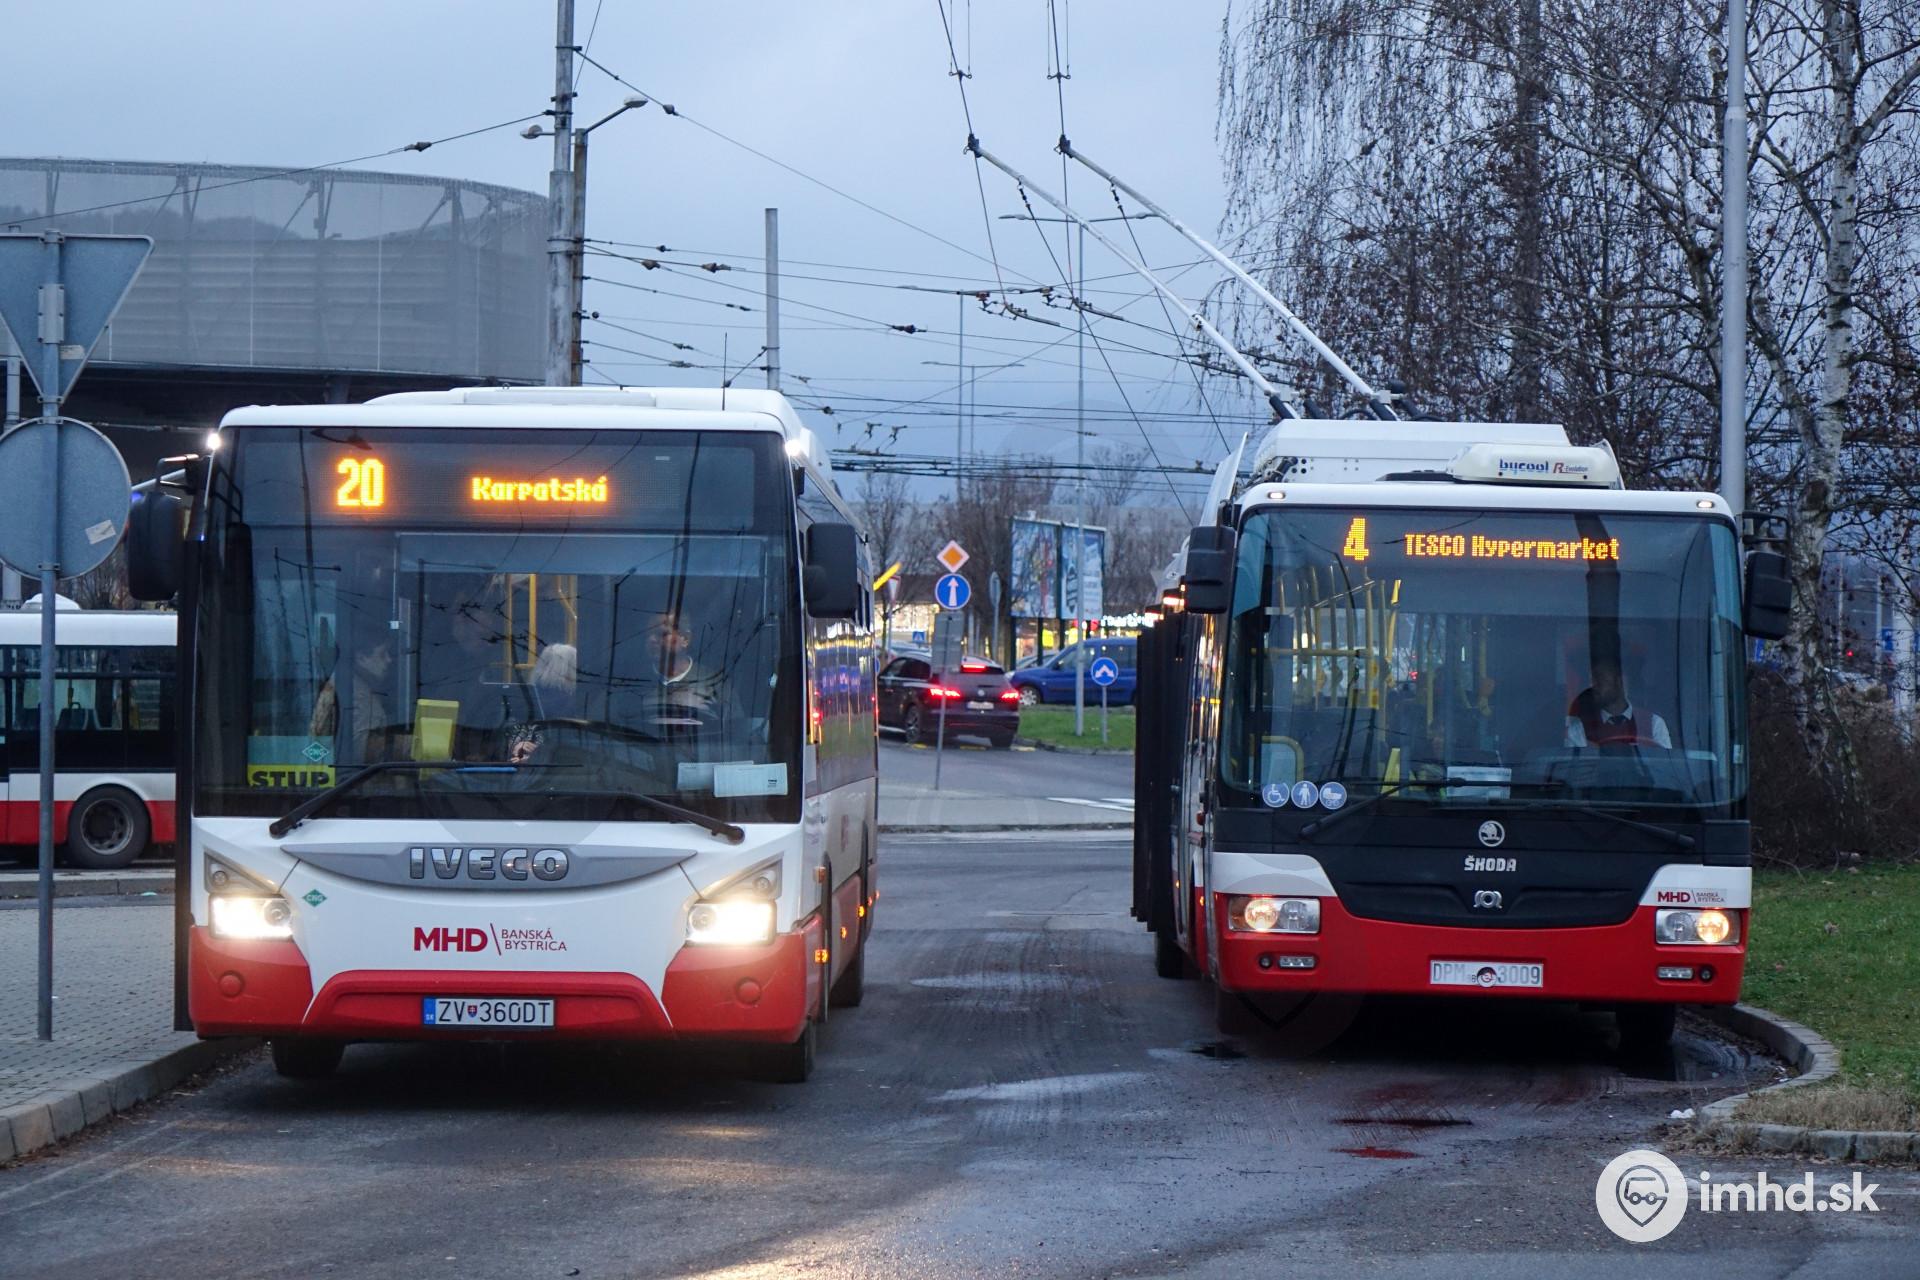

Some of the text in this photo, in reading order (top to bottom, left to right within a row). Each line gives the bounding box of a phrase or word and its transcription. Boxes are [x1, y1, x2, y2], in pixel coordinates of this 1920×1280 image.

[337, 458, 607, 506] 20 Karpatská
[1343, 518, 1619, 561] 4 TESCO Hypermarket
[409, 847, 570, 881] IVECO
[1464, 855, 1517, 872] ŠKODA
[1657, 891, 1691, 903] MHD
[413, 927, 553, 952] MHD BANSKÁ
[505, 940, 567, 952] BYSTRICA
[1433, 963, 1466, 982] DPM
[1498, 965, 1541, 984] 3009
[438, 1001, 465, 1022] ZV
